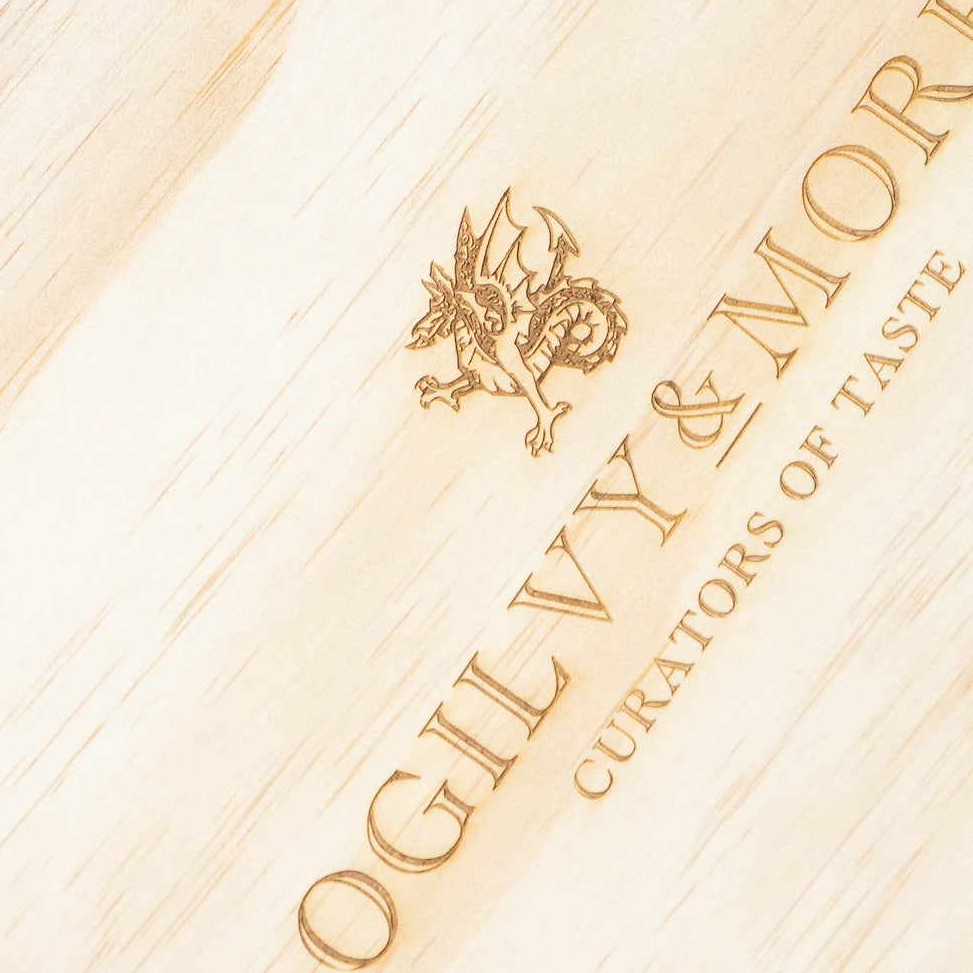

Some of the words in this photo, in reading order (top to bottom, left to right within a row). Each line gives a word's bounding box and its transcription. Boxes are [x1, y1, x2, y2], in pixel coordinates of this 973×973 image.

[298, 434, 687, 970] OGILVY
[651, 370, 744, 449] &
[574, 512, 784, 801] CURATORS
[780, 424, 838, 500] OF
[831, 250, 966, 417] TASTE
